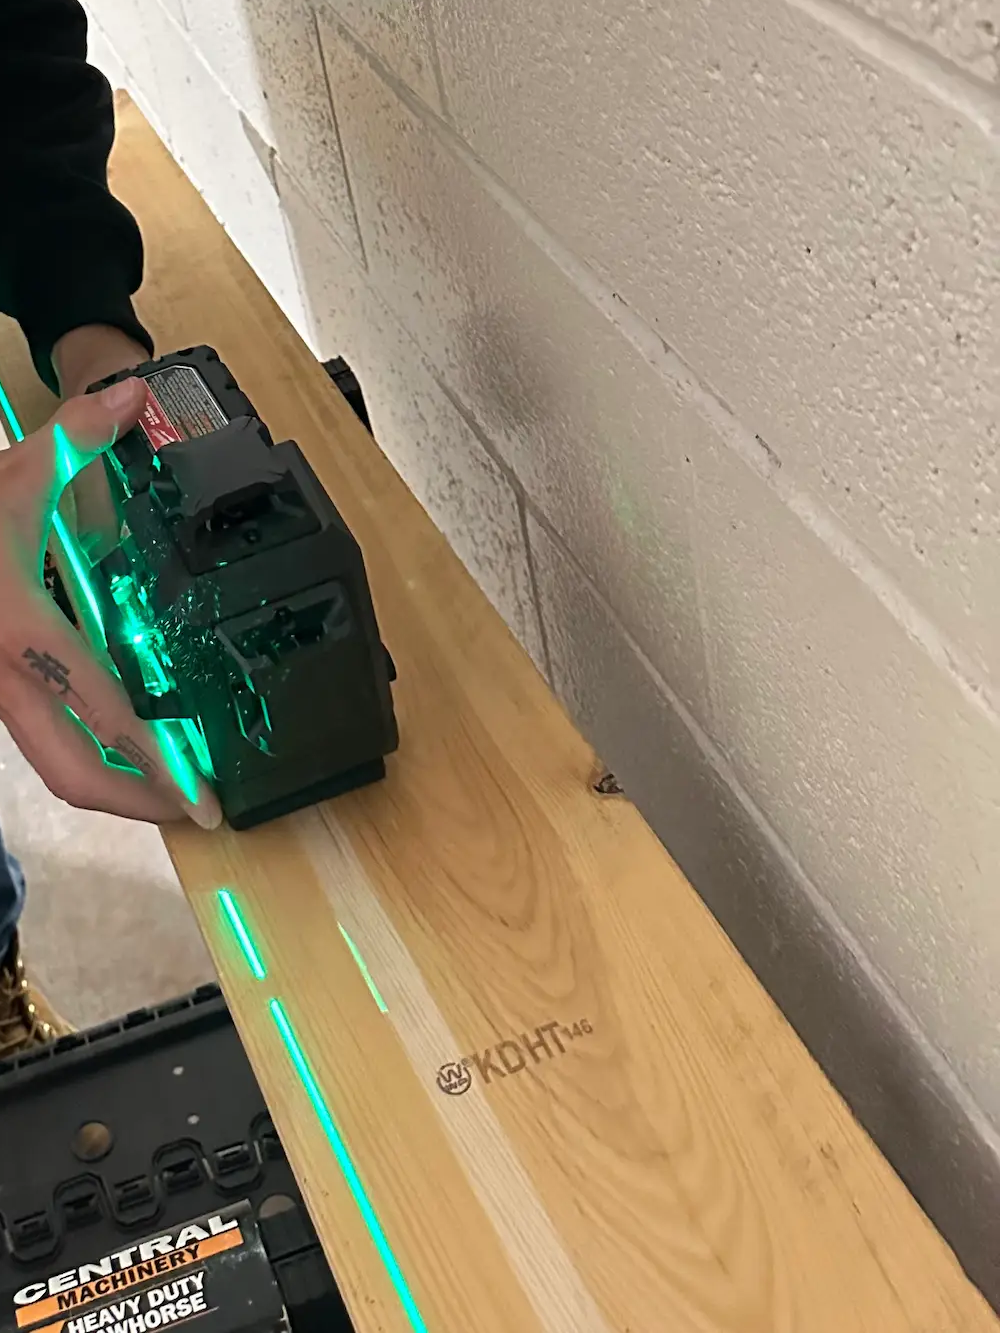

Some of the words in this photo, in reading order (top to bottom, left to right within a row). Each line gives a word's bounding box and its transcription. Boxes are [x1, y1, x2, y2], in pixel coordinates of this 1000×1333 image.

[472, 1021, 566, 1084] KDHT
[13, 1215, 239, 1306] CENTRAL
[56, 1244, 201, 1311] MACHINERY
[67, 1295, 141, 1333] HEAVY
[146, 1271, 205, 1309] DUTY
[96, 1291, 207, 1333] WHORSE
